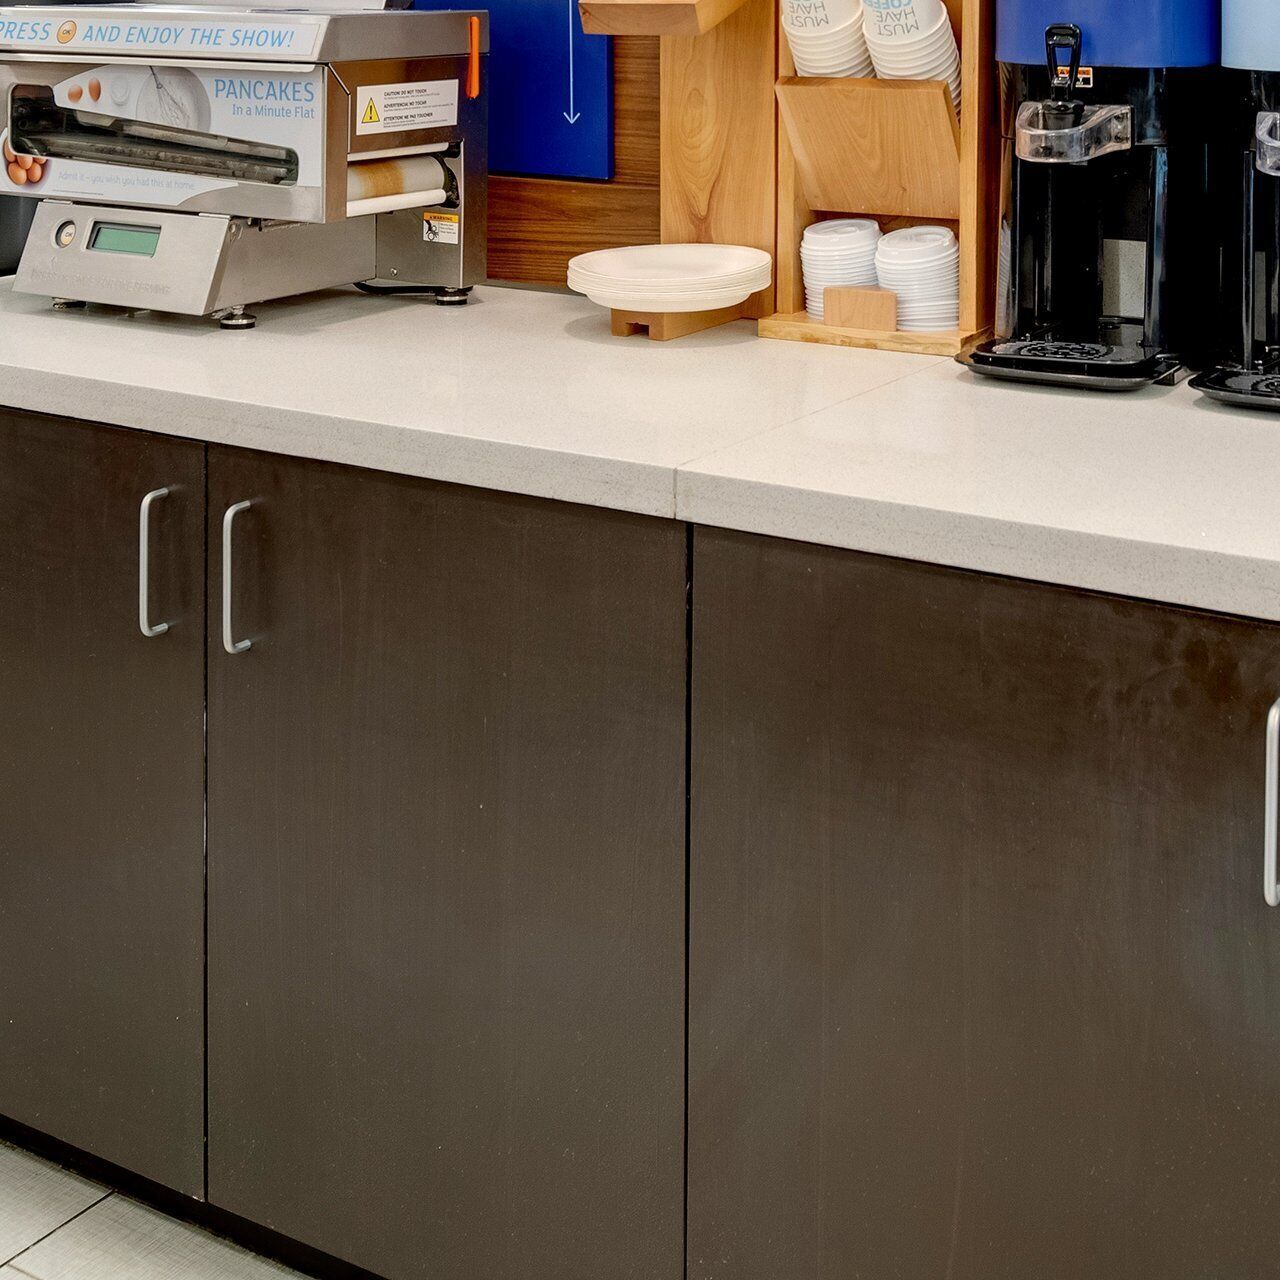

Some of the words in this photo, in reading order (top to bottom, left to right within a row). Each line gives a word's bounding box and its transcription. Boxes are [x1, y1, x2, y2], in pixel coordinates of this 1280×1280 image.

[82, 25, 120, 43] AND
[125, 26, 184, 45] ENJOY
[190, 27, 225, 46] THE
[229, 29, 295, 48] SHOW!
[214, 78, 315, 103] PANCAKES
[232, 104, 243, 116] In
[245, 107, 252, 116] a
[254, 104, 292, 118] Minute
[294, 106, 315, 119] Flat
